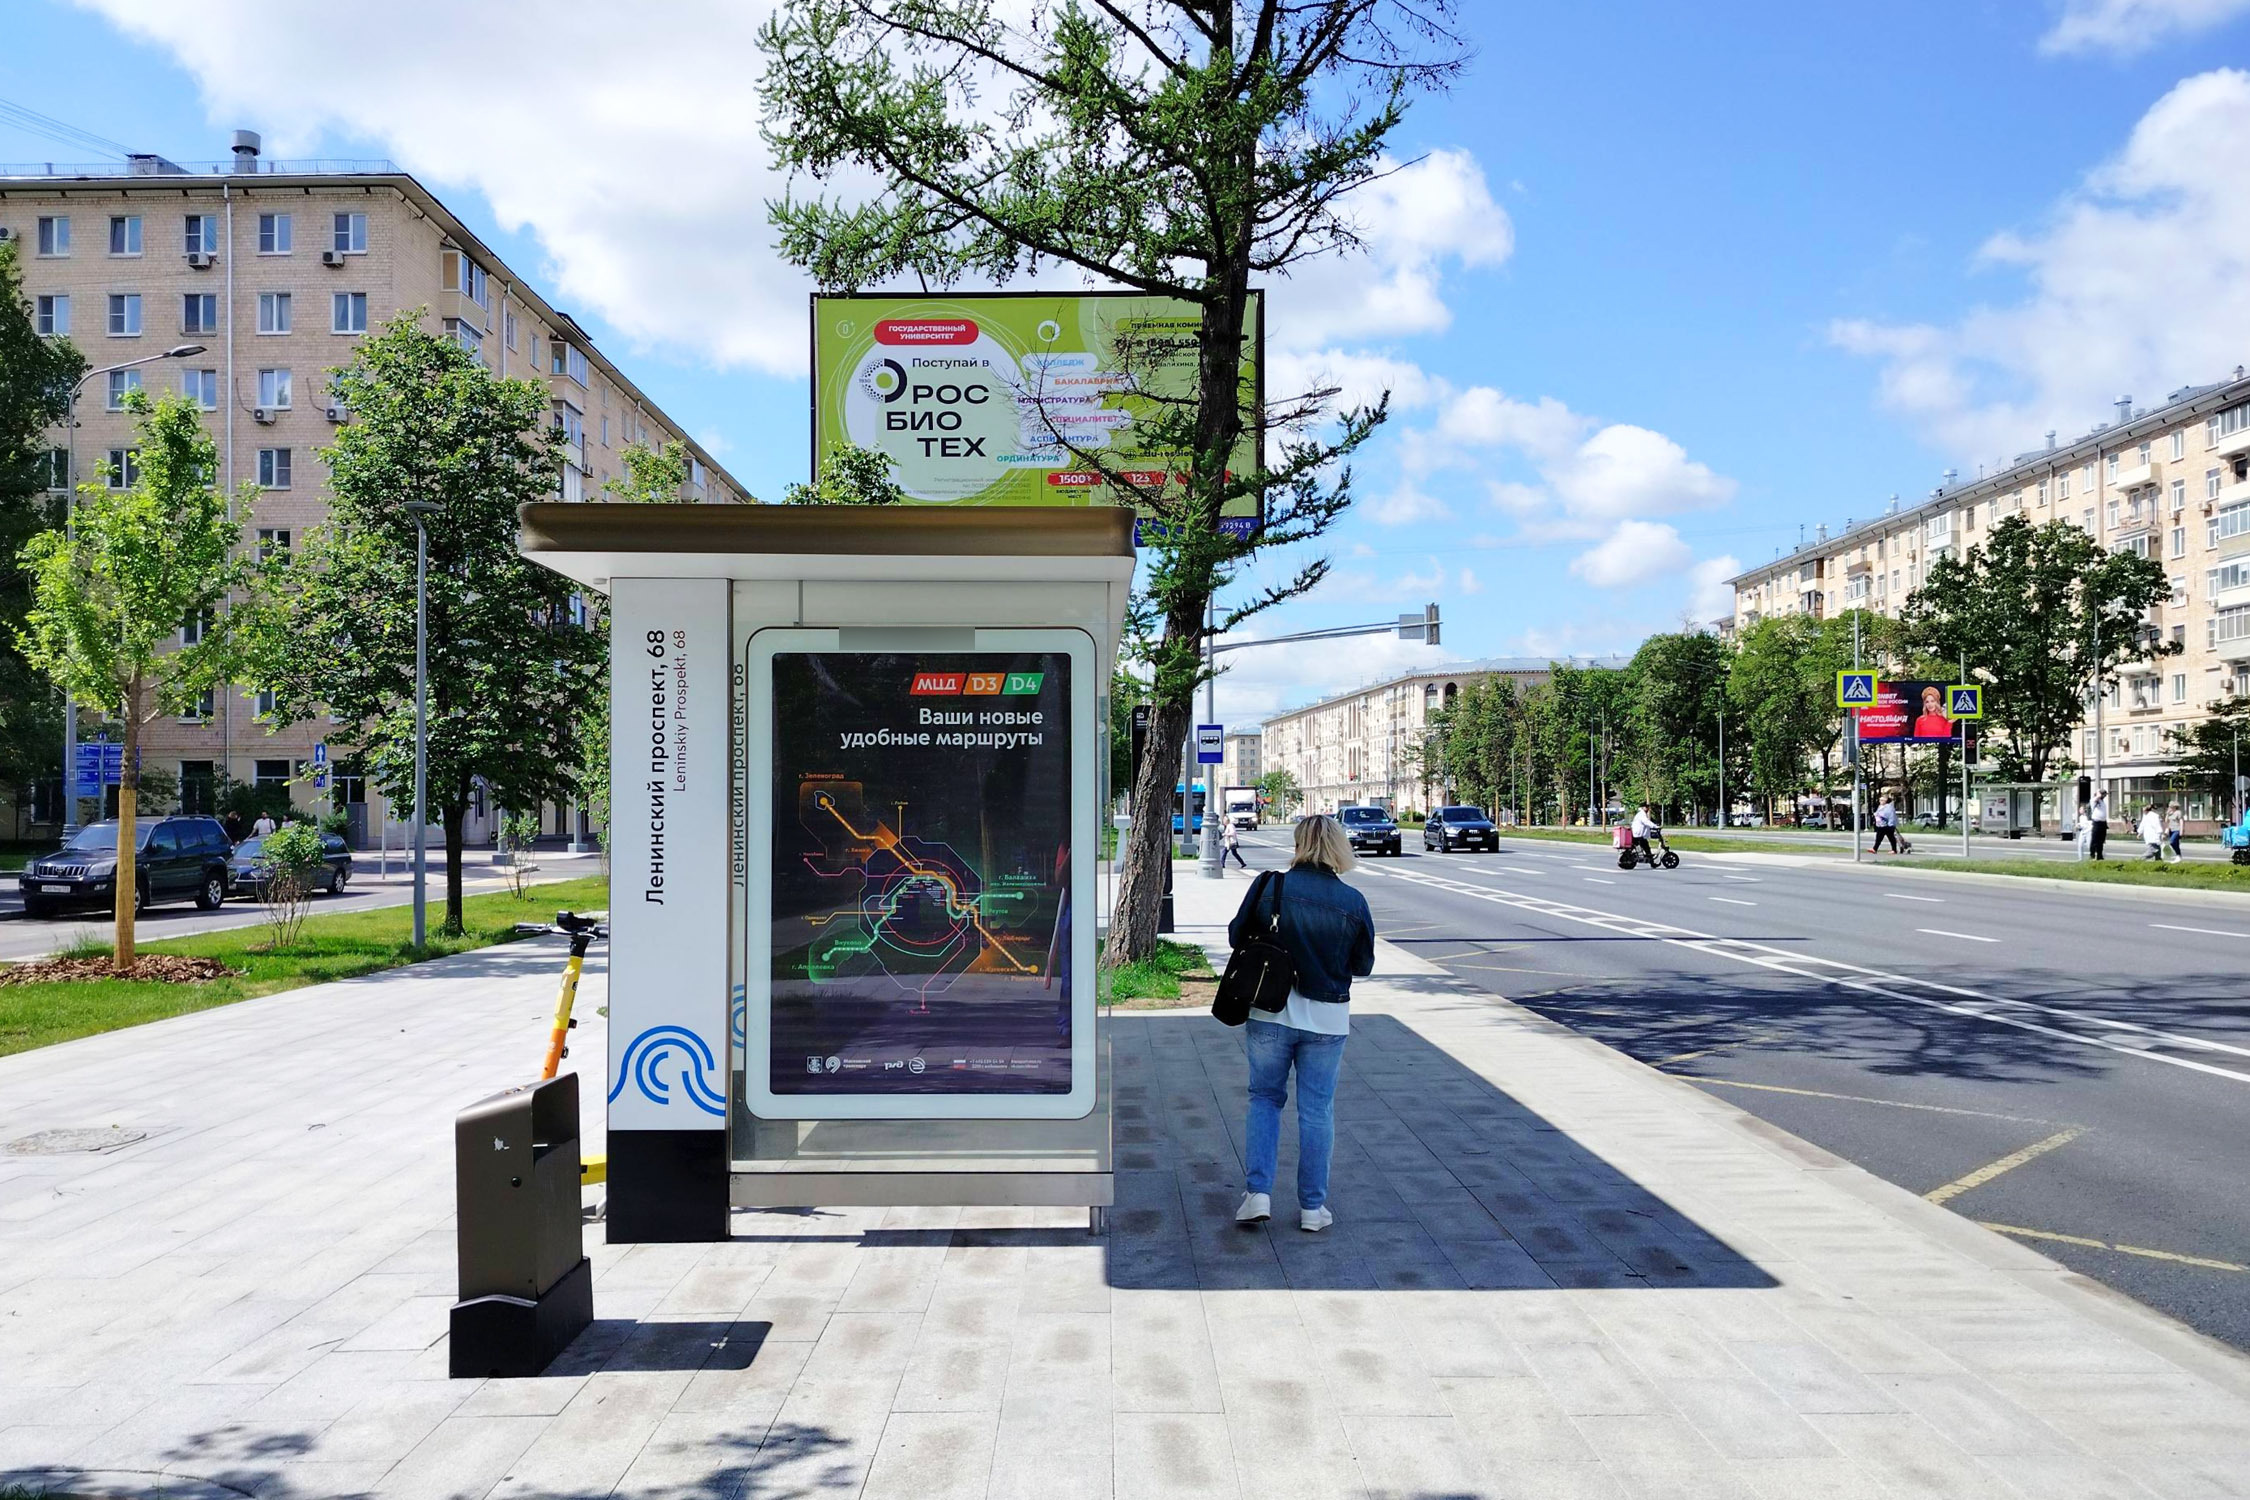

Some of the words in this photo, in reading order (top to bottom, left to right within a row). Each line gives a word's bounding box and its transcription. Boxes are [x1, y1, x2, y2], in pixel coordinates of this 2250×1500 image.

[888, 324, 966, 332] ГОСУДАРСТВЕННЫЙ
[912, 357, 978, 369] Поступай
[912, 384, 989, 404] РОС
[886, 411, 962, 431] БИО
[916, 437, 986, 457] ТЕХ
[996, 455, 1060, 463] ОРДИНАТУРА
[646, 629, 665, 658] 68
[673, 630, 686, 649] 68
[673, 653, 689, 720] Prospekt,
[916, 678, 957, 692] МЦД
[972, 677, 997, 691] D3
[1011, 677, 1037, 691] D4
[651, 665, 669, 773] проспект,
[919, 708, 973, 725] Ваши
[979, 712, 1043, 725] новые
[840, 728, 931, 749] удобные
[936, 732, 1043, 749] маршруты
[673, 724, 689, 792] Leninskiy
[645, 780, 664, 905] Ленинский
